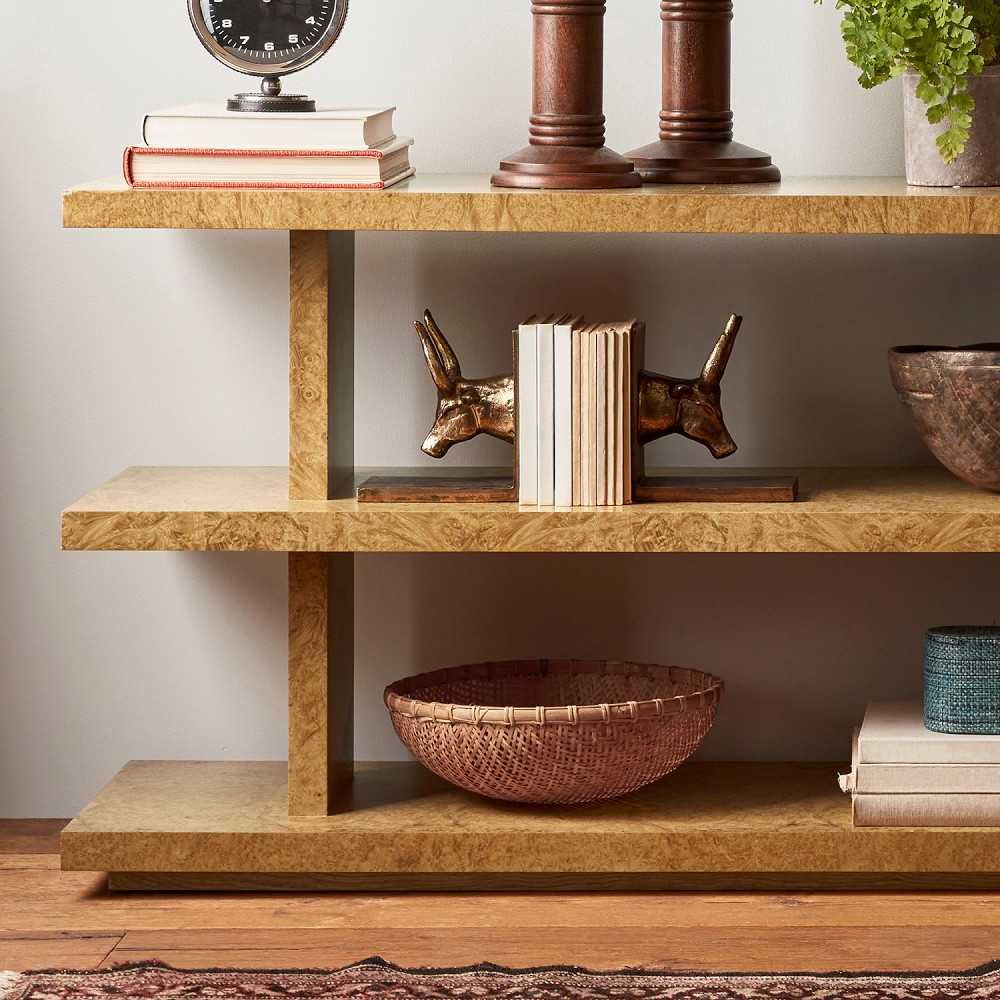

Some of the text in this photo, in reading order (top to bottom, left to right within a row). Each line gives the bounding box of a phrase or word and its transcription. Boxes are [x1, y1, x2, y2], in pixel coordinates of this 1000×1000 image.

[221, 19, 232, 27] 8
[305, 16, 315, 24] 4
[239, 36, 250, 44] 7
[288, 34, 298, 43] 5
[264, 42, 274, 50] 6
